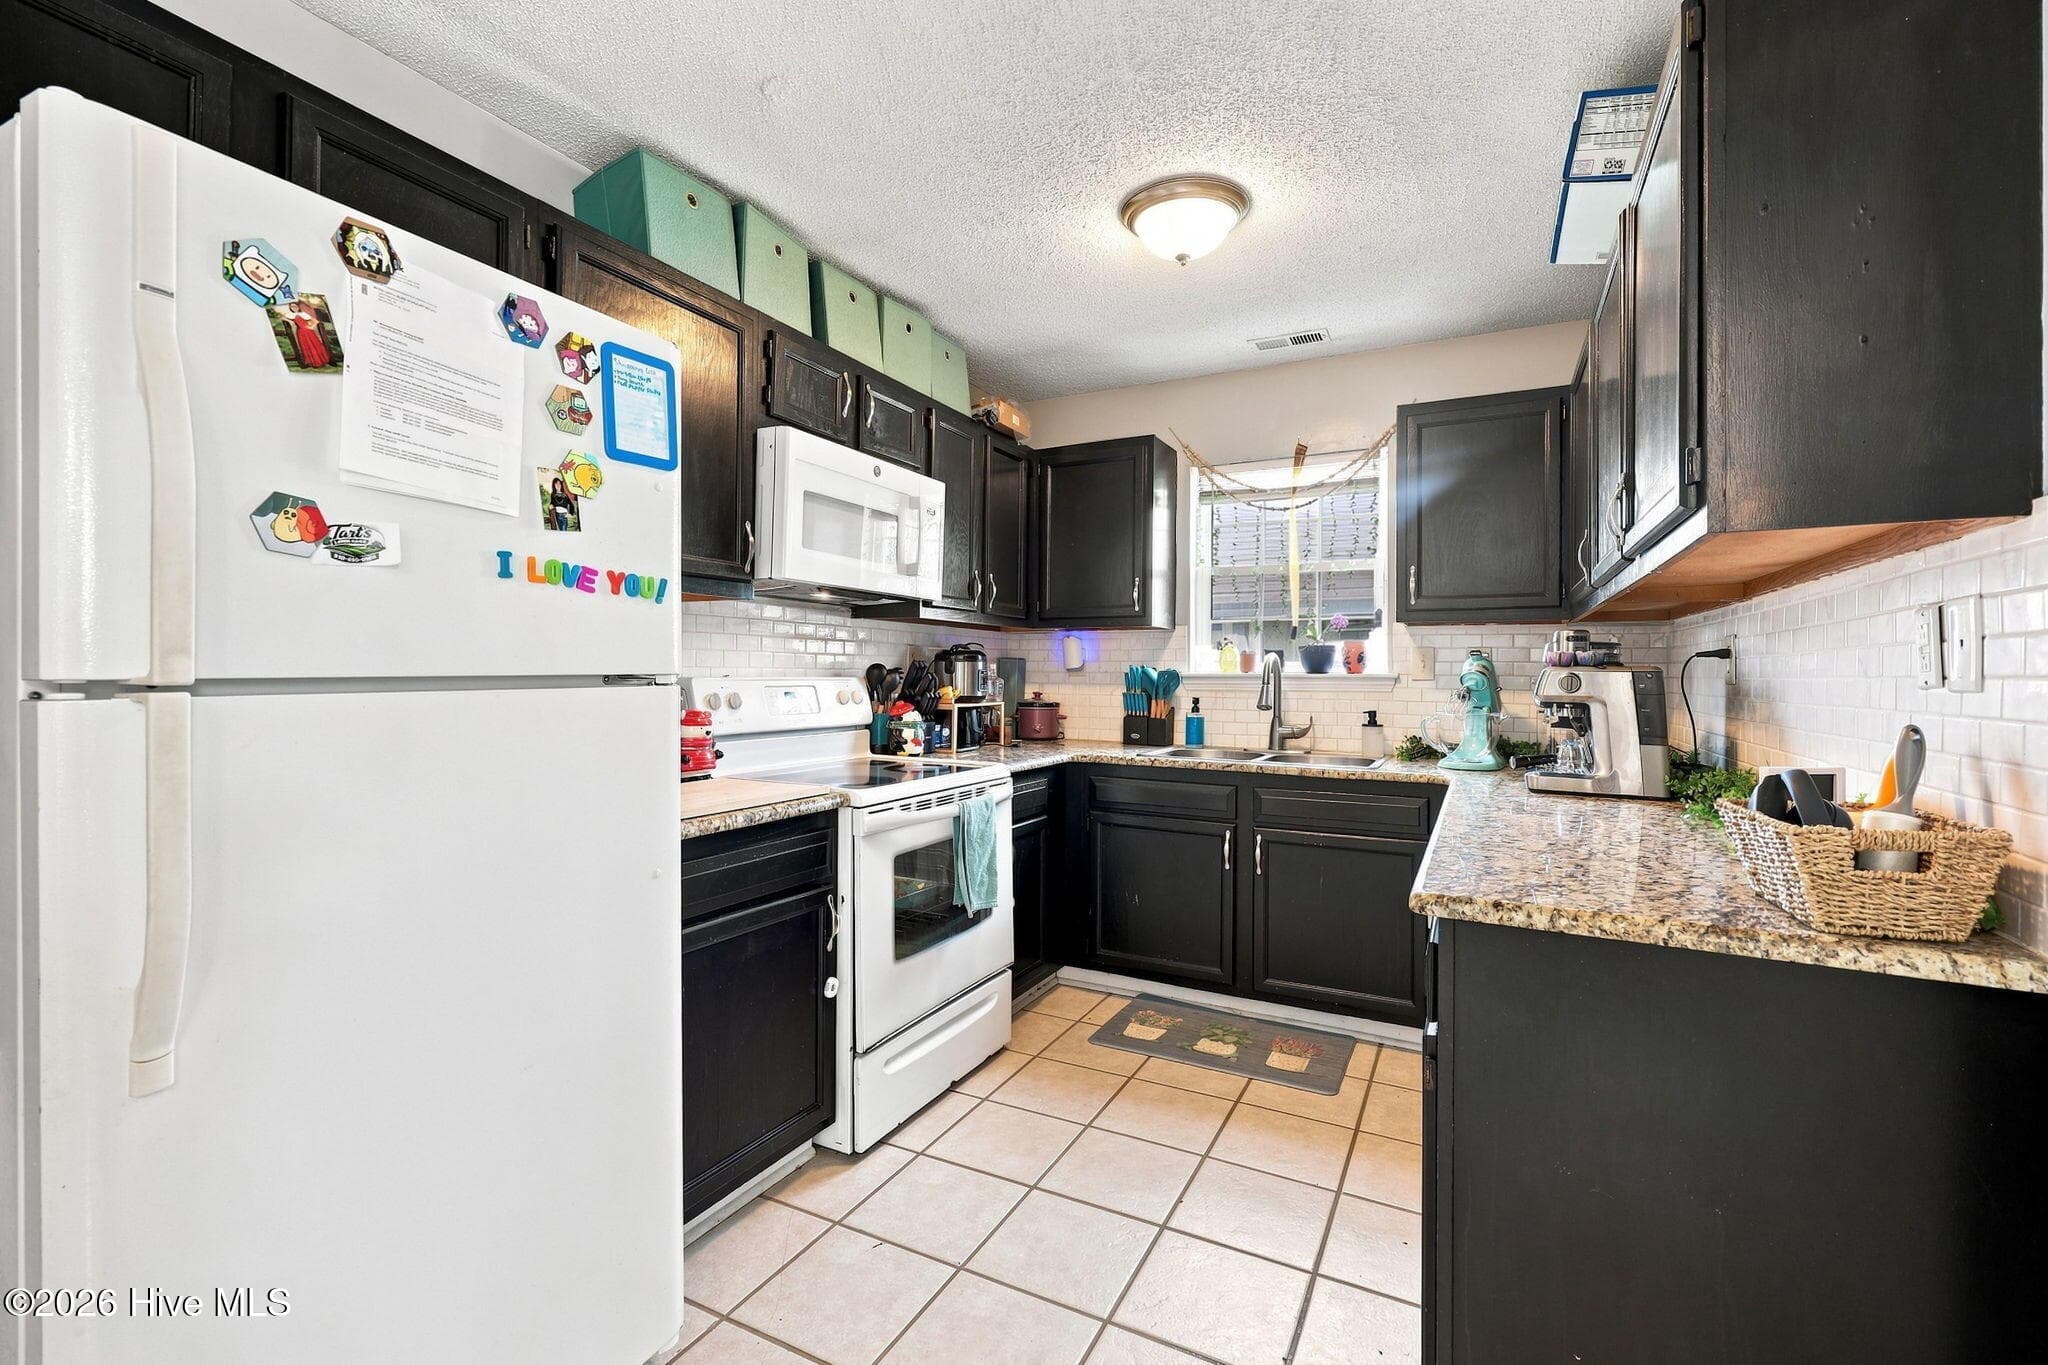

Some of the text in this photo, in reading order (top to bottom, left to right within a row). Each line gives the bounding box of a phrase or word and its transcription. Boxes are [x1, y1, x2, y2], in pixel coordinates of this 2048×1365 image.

[327, 523, 372, 539] Tart's
[497, 550, 668, 604] I LOVE YOU!
